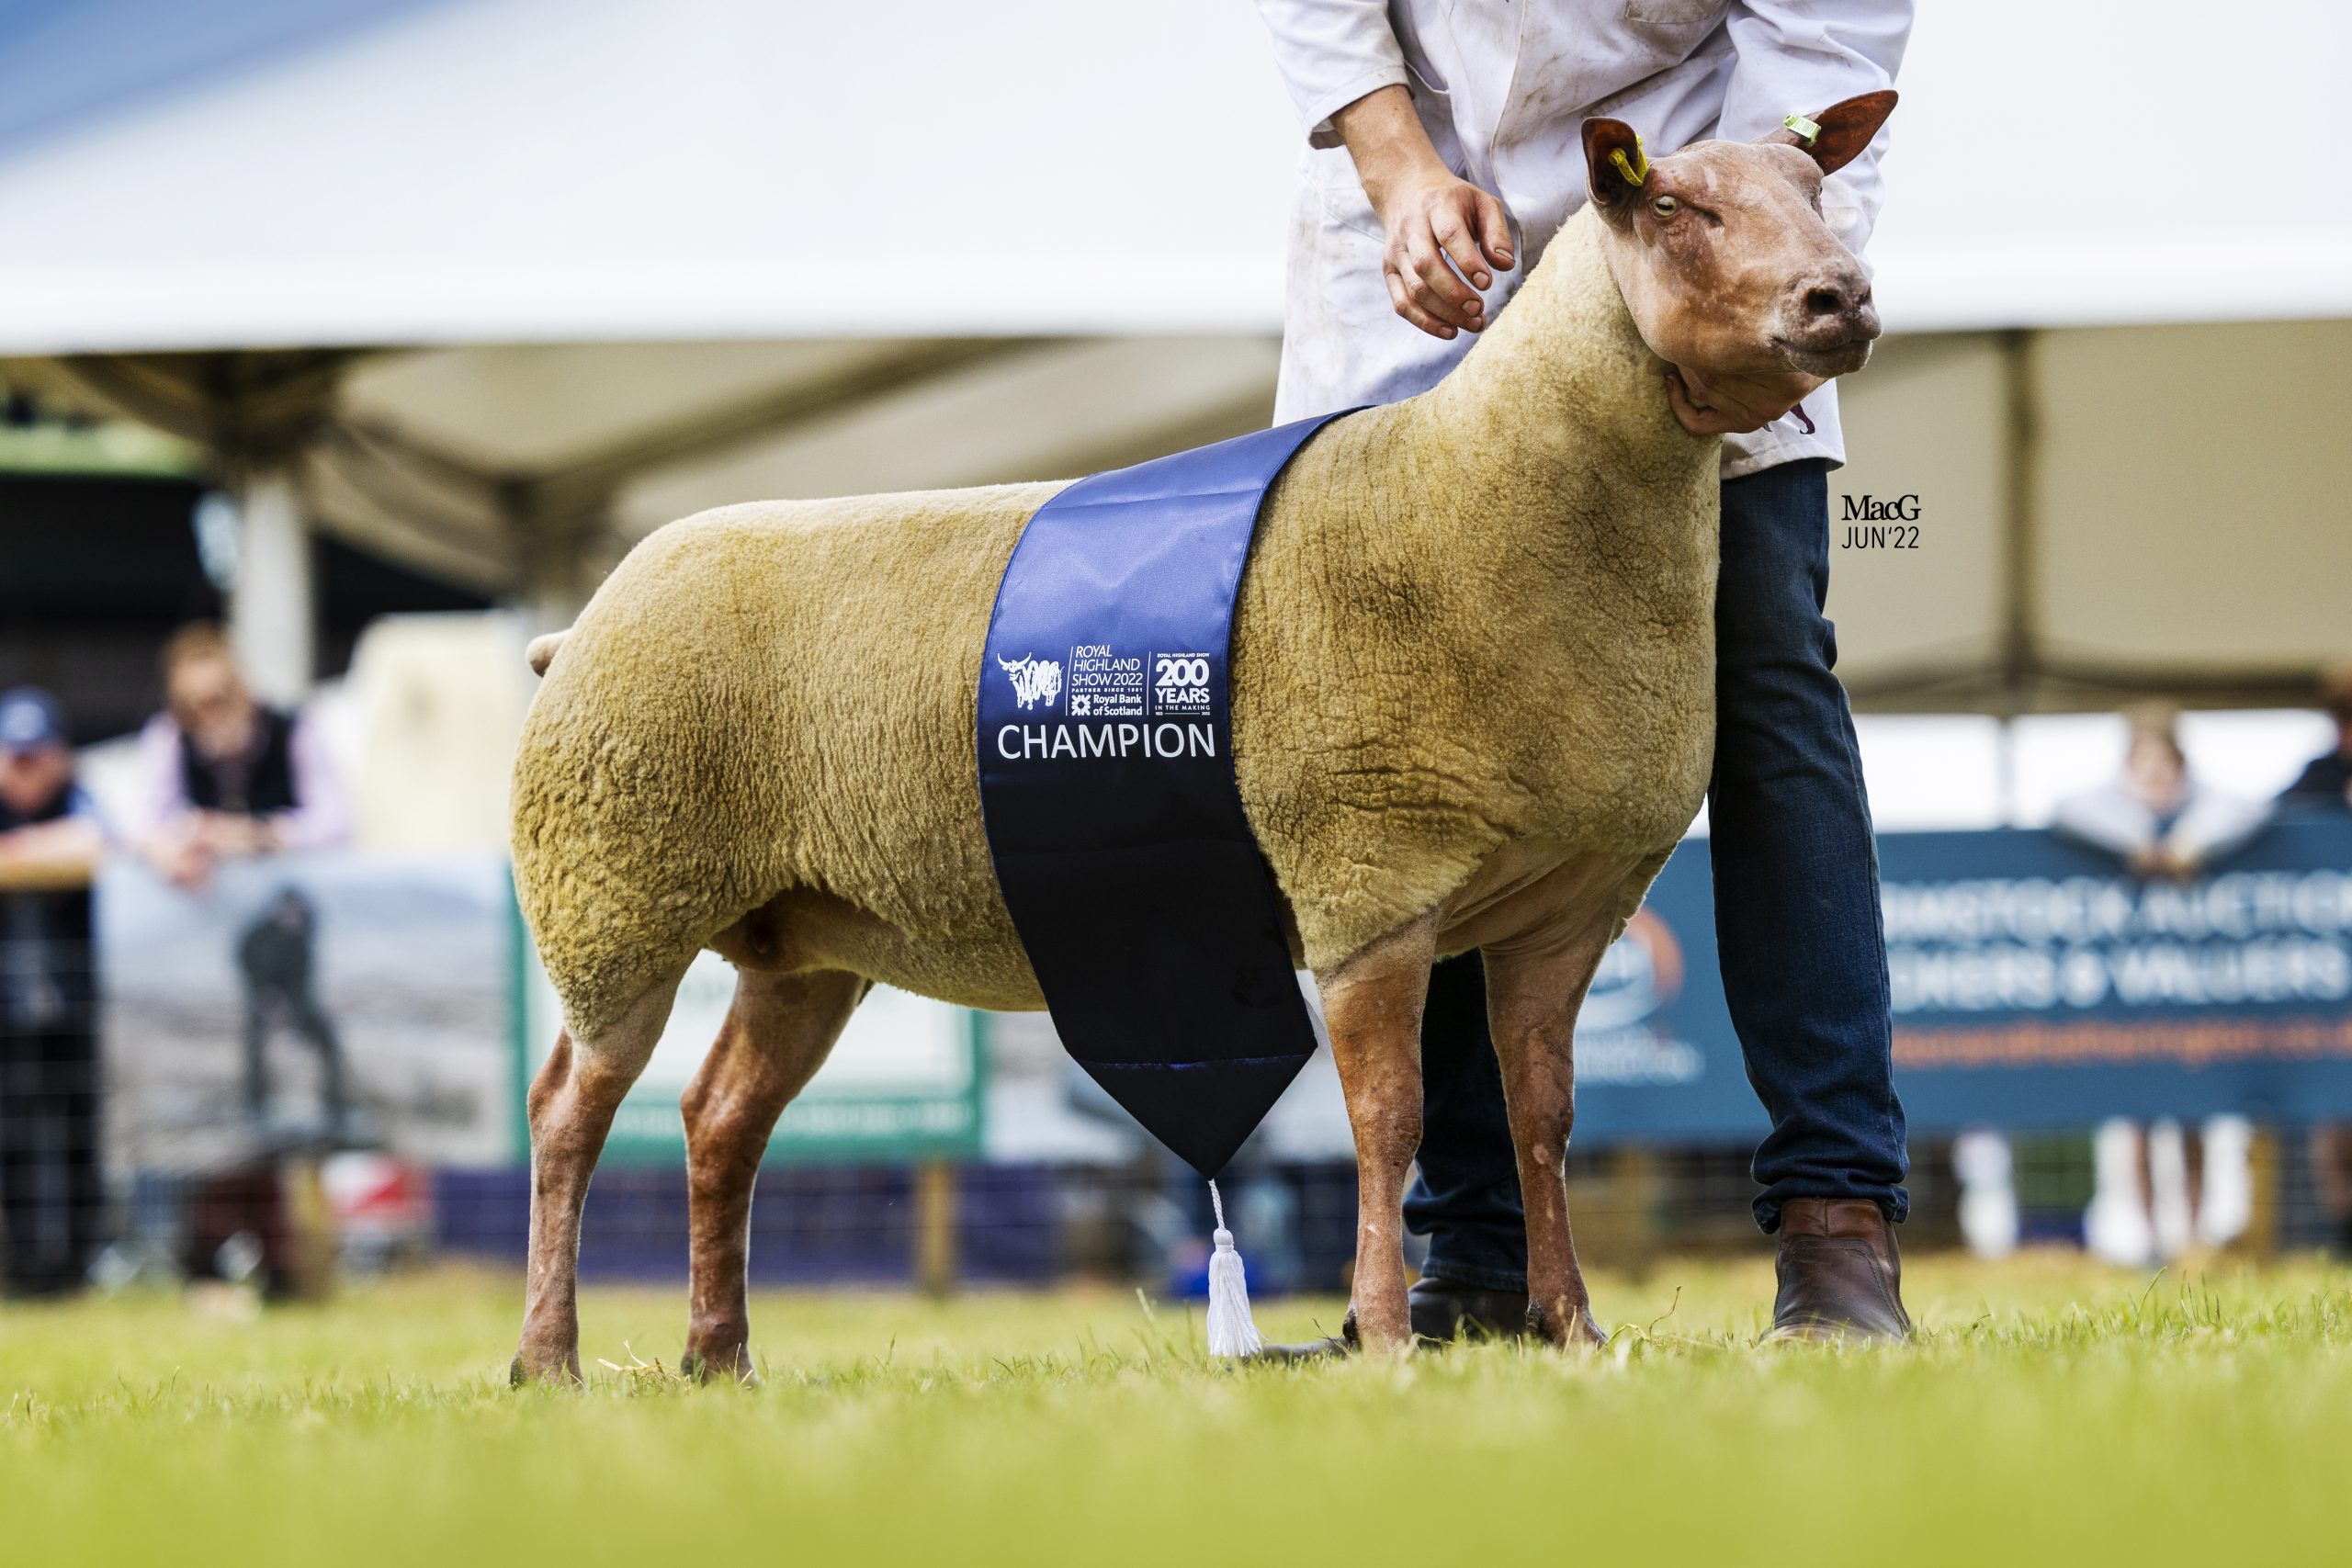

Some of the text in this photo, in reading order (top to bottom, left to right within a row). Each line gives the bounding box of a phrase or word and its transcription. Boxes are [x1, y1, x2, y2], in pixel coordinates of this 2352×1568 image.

[1076, 645, 1113, 658] ROYAL
[1073, 659, 1141, 671] HIGHLAND
[1155, 658, 1210, 686] 200
[1071, 672, 1143, 686] SHOW 2022
[1093, 694, 1142, 706] Royal Bank
[1154, 688, 1210, 704] YEARS
[1092, 705, 1143, 716] of Scotland
[997, 723, 1216, 759] CHAMPION
